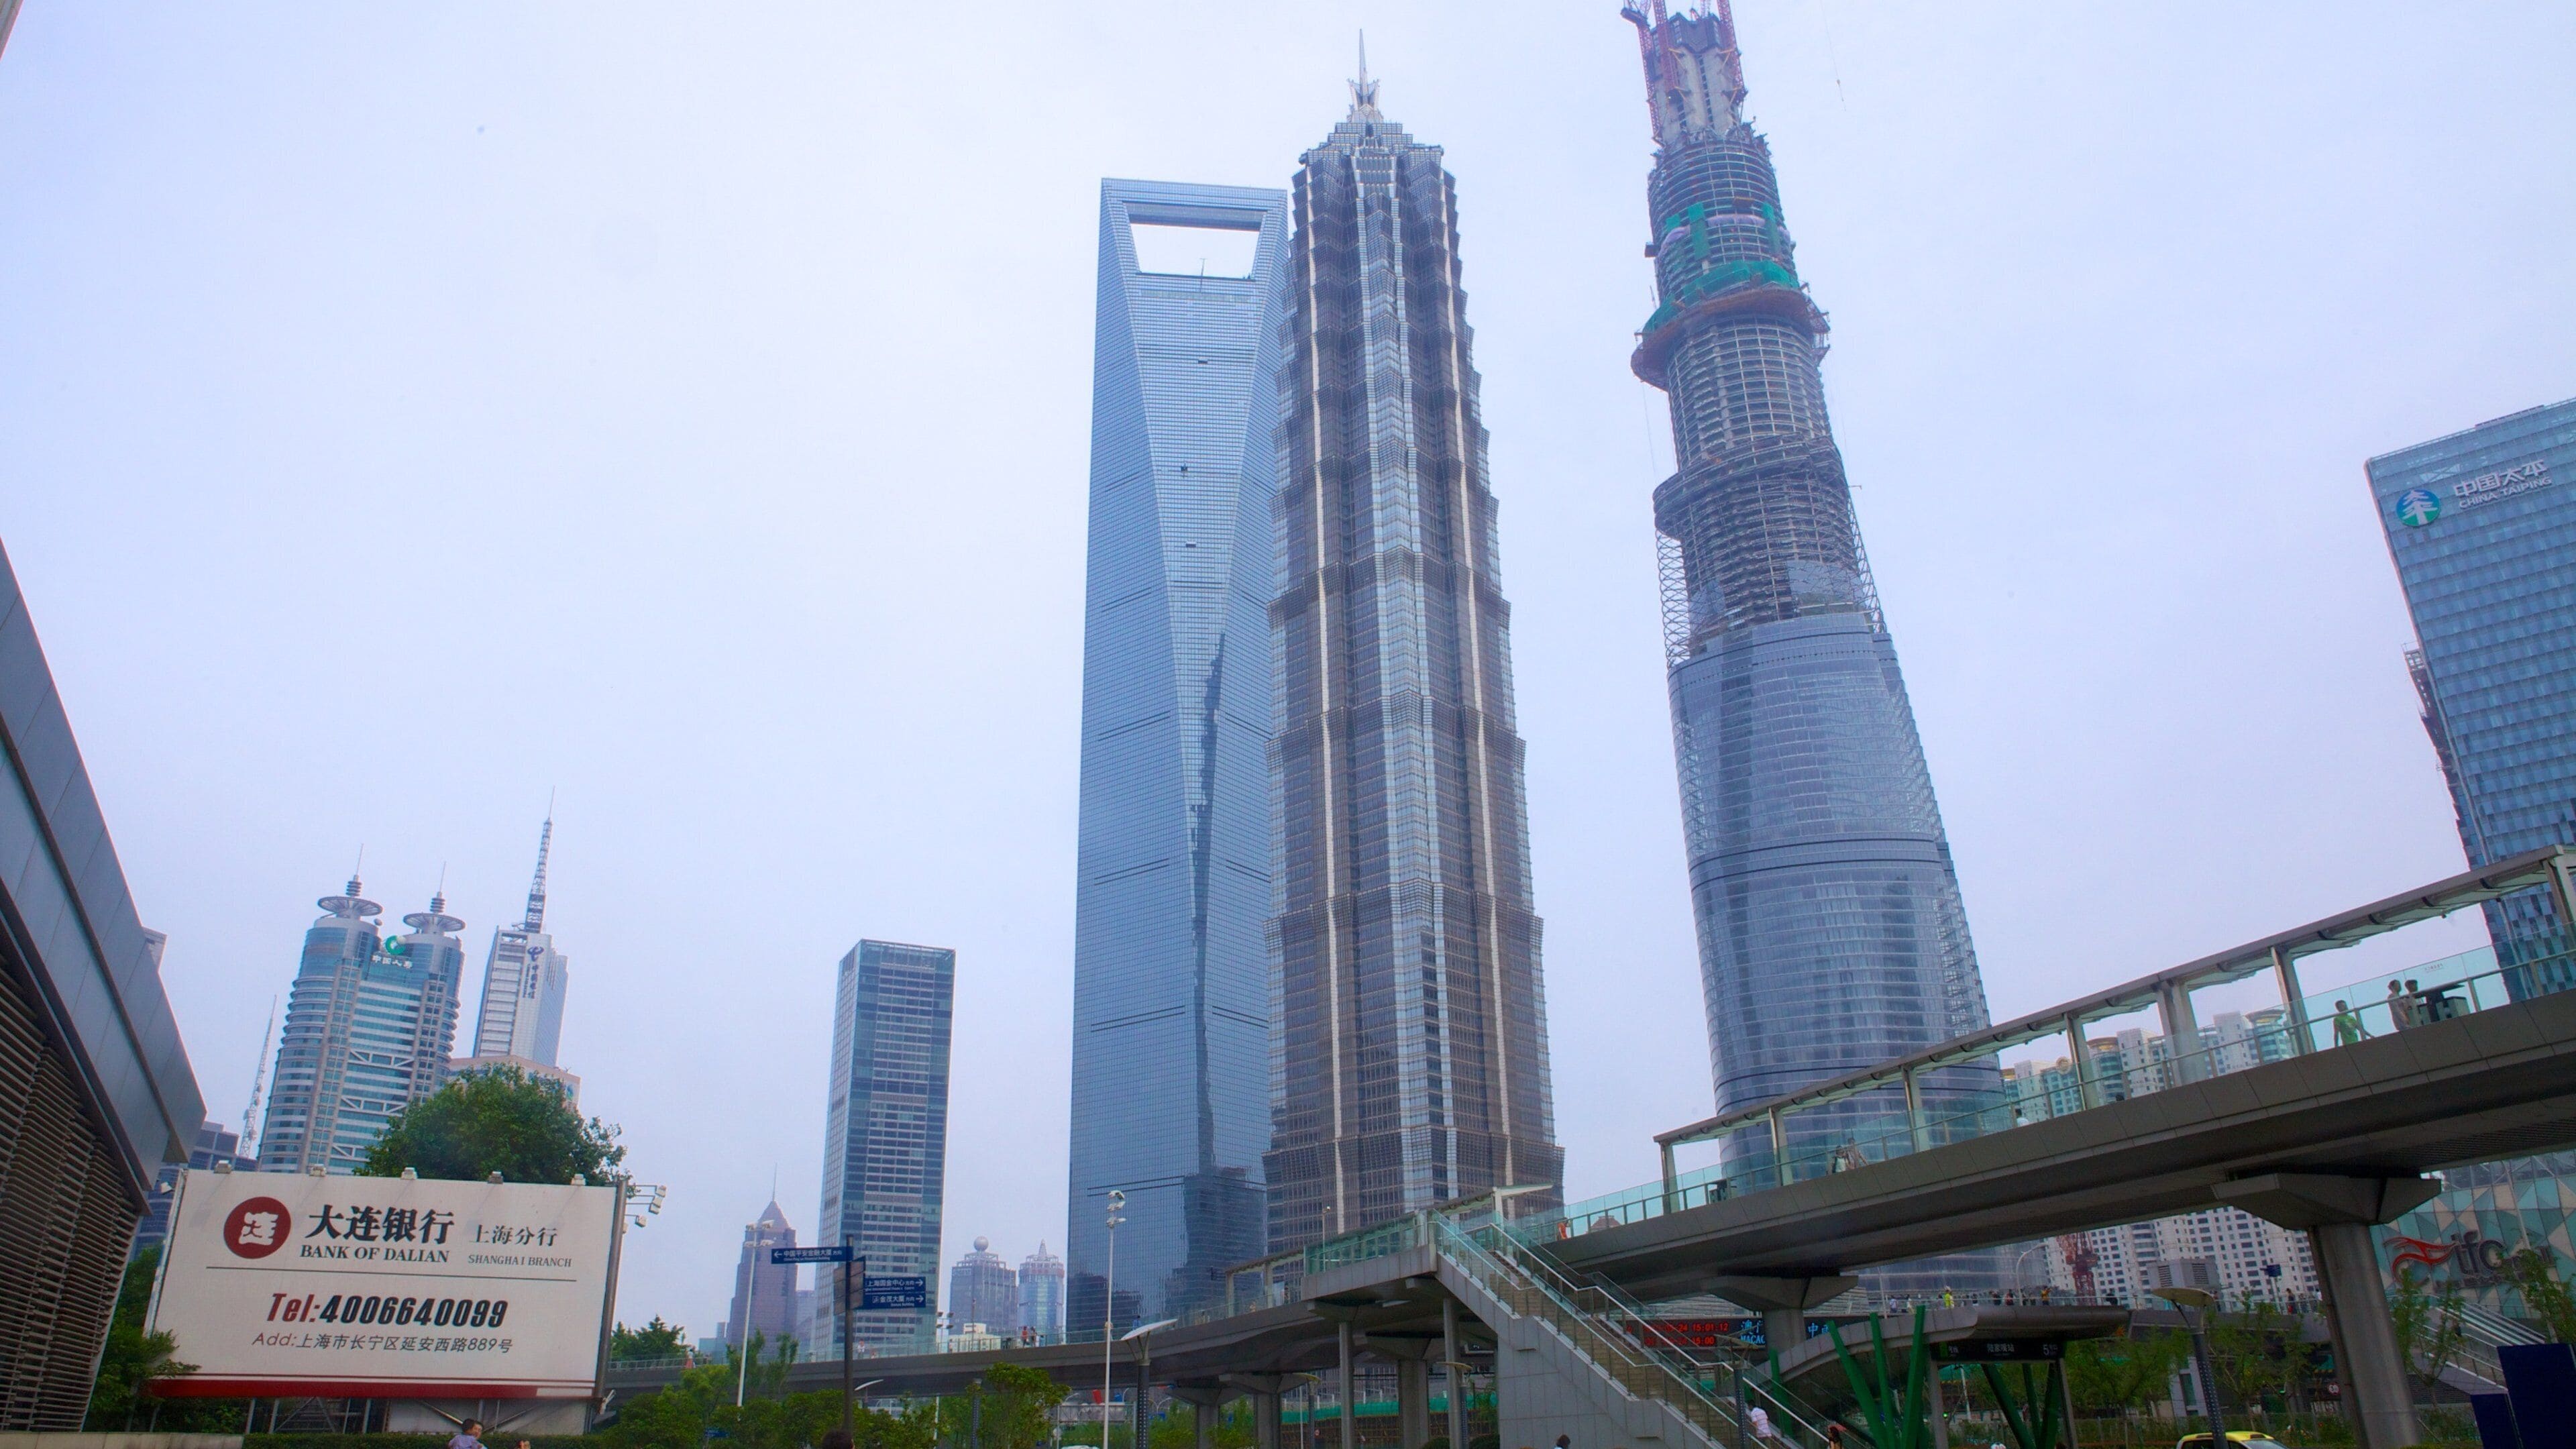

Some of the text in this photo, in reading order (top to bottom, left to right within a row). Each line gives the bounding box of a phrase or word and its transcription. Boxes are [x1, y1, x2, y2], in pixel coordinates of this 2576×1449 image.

[2453, 459, 2548, 496] 中国太平
[2459, 476, 2552, 508] CHINA TAIPING
[305, 1204, 455, 1245] 大连银行
[470, 1224, 558, 1246] 上海分行
[300, 1244, 451, 1263] BANK OF DALIAN
[468, 1254, 572, 1267] SHANGHAI BRANCH
[266, 1293, 508, 1328] Tel:4006640099
